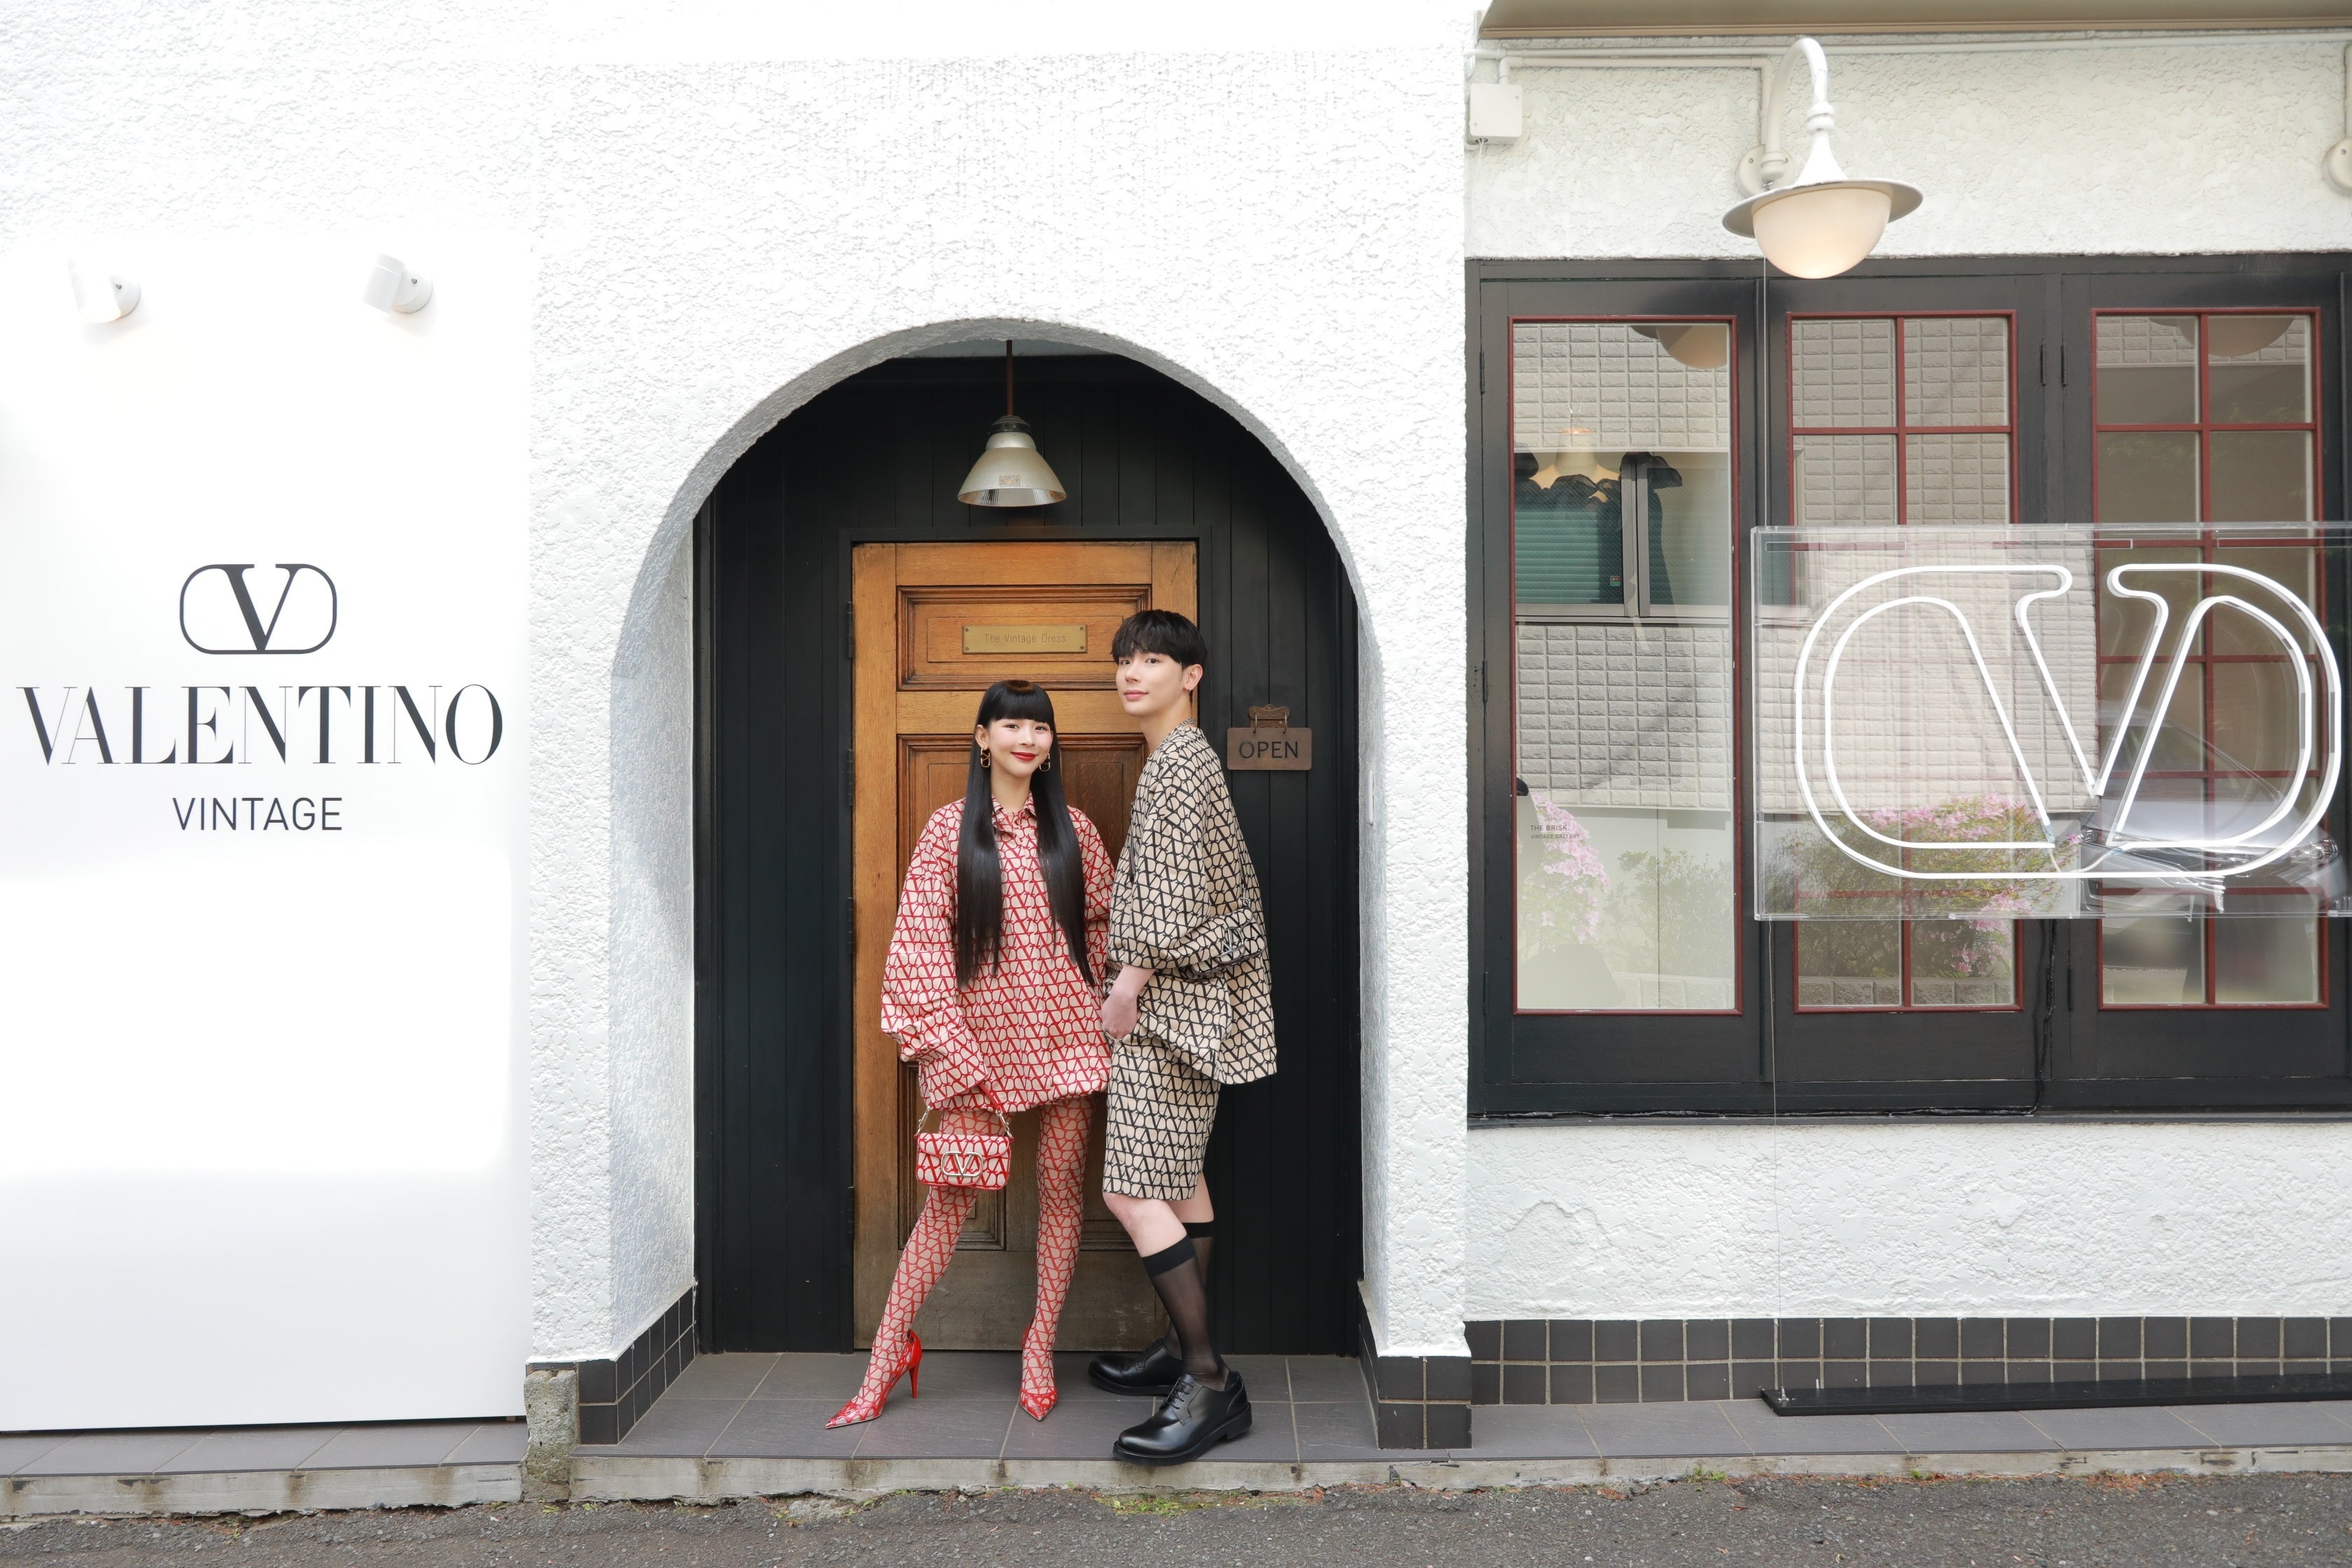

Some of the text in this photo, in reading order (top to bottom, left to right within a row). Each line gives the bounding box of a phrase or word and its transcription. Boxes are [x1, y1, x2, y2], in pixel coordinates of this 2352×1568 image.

[985, 634, 1066, 644] The Vintage Dress
[15, 685, 503, 766] VALENTINO
[1239, 741, 1298, 759] OPEN
[172, 797, 342, 831] VINTAGE
